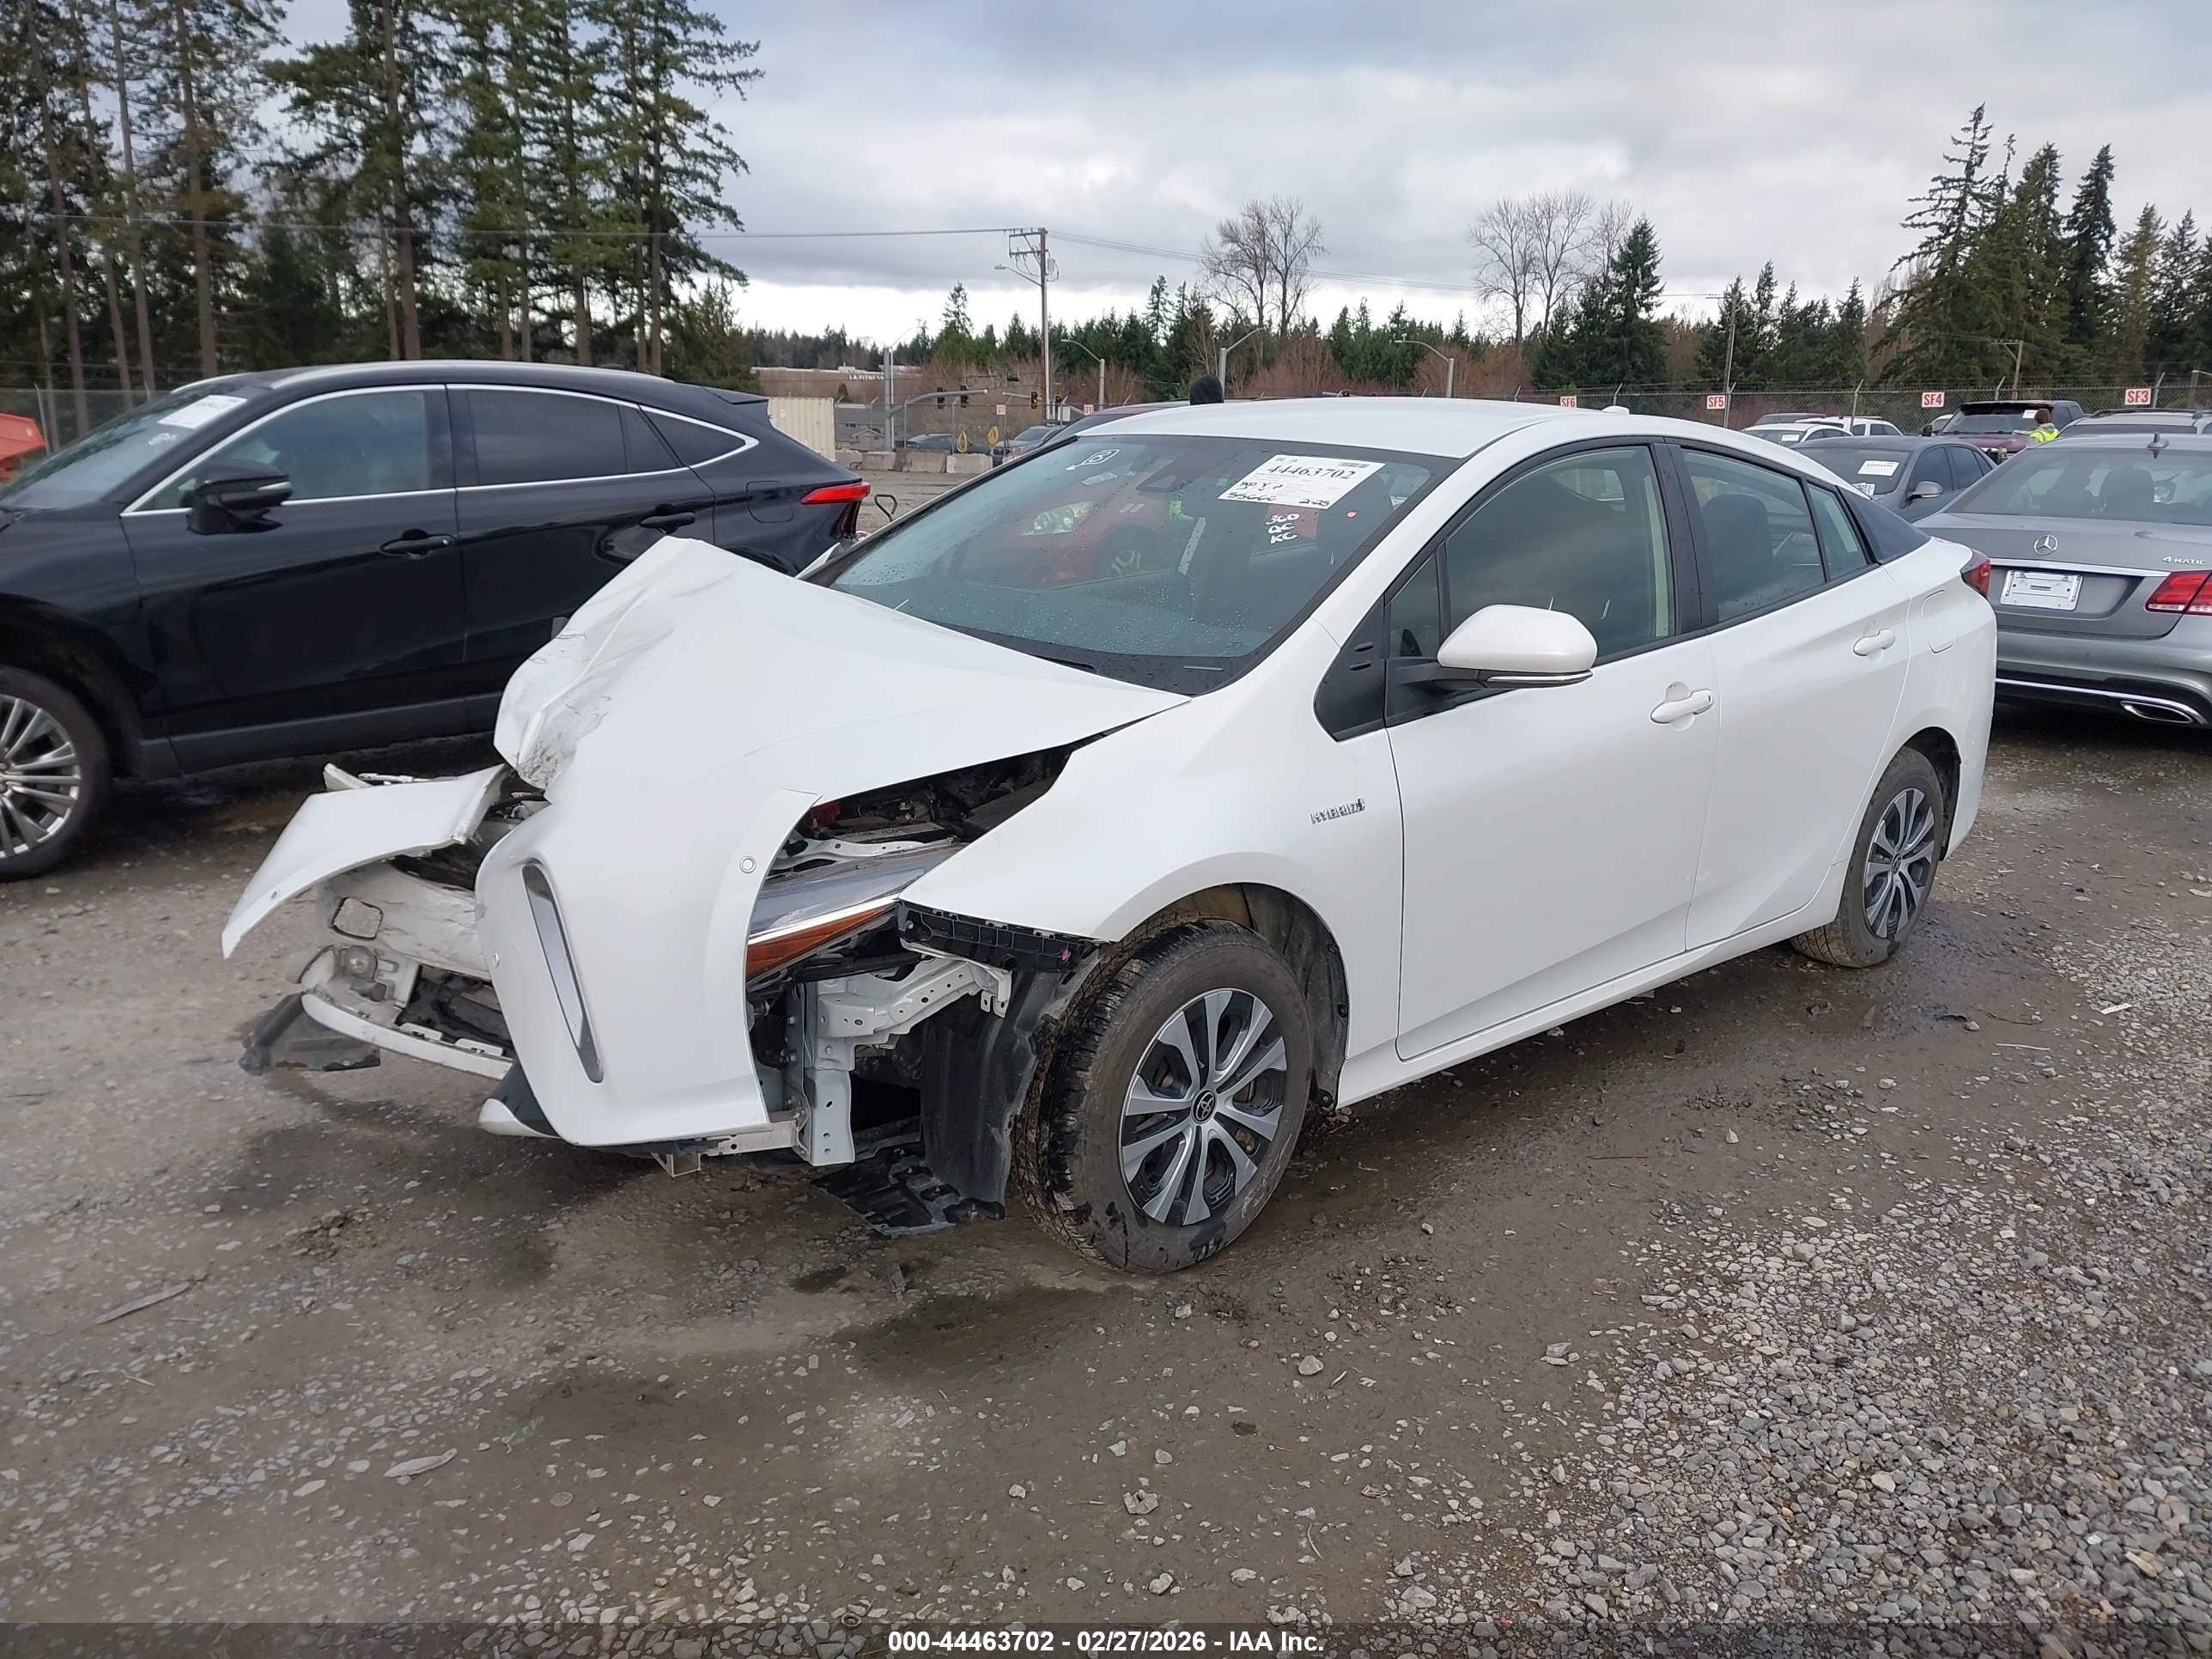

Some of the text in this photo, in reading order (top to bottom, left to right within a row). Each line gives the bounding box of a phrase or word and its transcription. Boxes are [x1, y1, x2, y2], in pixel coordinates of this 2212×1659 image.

[1560, 398, 1576, 408] SF6
[1708, 397, 1724, 409] SF5
[1923, 393, 1943, 406] SF4
[2127, 390, 2149, 404] SF3
[1267, 465, 1356, 480] 44463702
